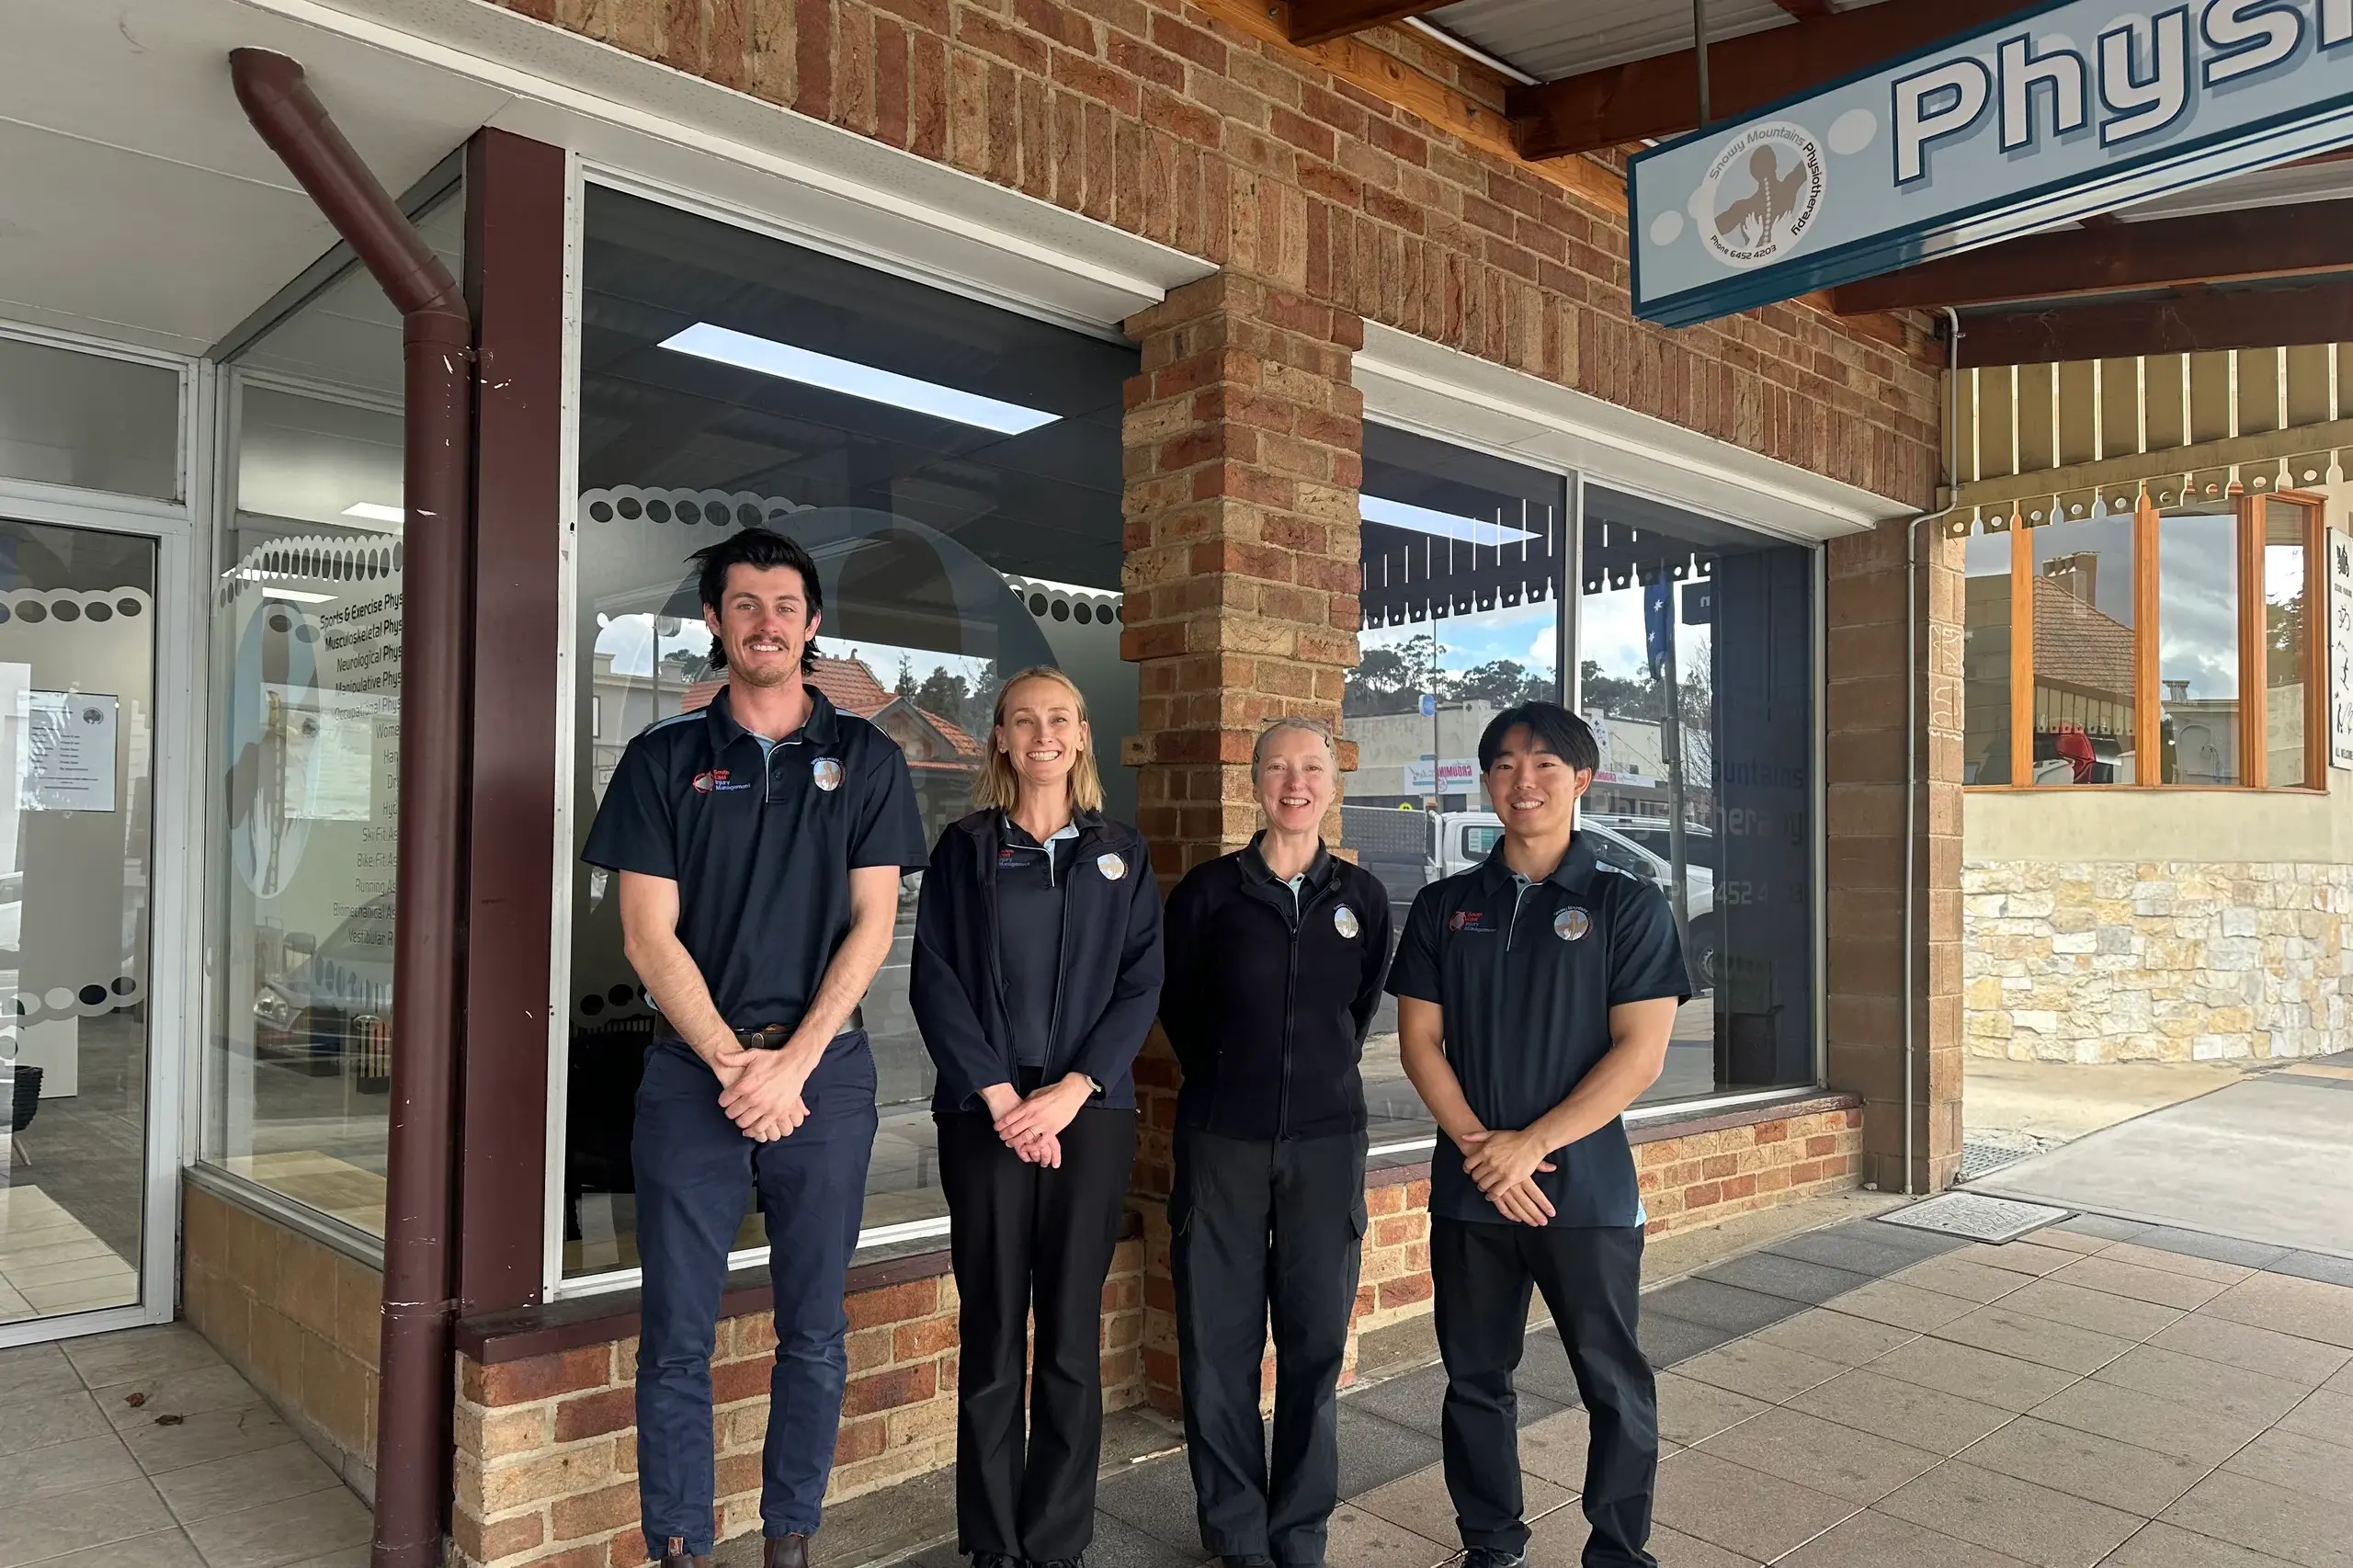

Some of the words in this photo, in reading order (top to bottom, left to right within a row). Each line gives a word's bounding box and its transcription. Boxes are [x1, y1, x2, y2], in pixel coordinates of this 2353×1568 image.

[1710, 141, 1745, 180] Snowy
[1747, 127, 1806, 146] Mountains
[1791, 142, 1823, 236] Physiotherapy
[1711, 234, 1729, 255] Phone
[1730, 250, 1752, 260] 6452
[1753, 244, 1777, 258] 4203
[320, 610, 343, 631] Sports
[344, 607, 350, 621] &
[351, 598, 382, 619] Exercise
[384, 593, 403, 610] Phys
[325, 621, 382, 652] Musculoskeletal
[383, 619, 402, 636] Phys
[337, 647, 381, 673] Neurological
[383, 644, 402, 662] Phys
[335, 676, 381, 697] Manipulative
[382, 670, 401, 688] Phys
[335, 699, 381, 721] Occupational
[382, 696, 401, 714] Phys
[376, 723, 400, 739] Wome
[383, 749, 398, 764] Han
[362, 827, 374, 842] Ski
[376, 827, 386, 842] Fit
[358, 853, 373, 868] Bike
[375, 853, 385, 868] Fit
[356, 878, 384, 897] Running
[334, 902, 384, 920] Biomechanical
[348, 927, 385, 946] Vestibular
